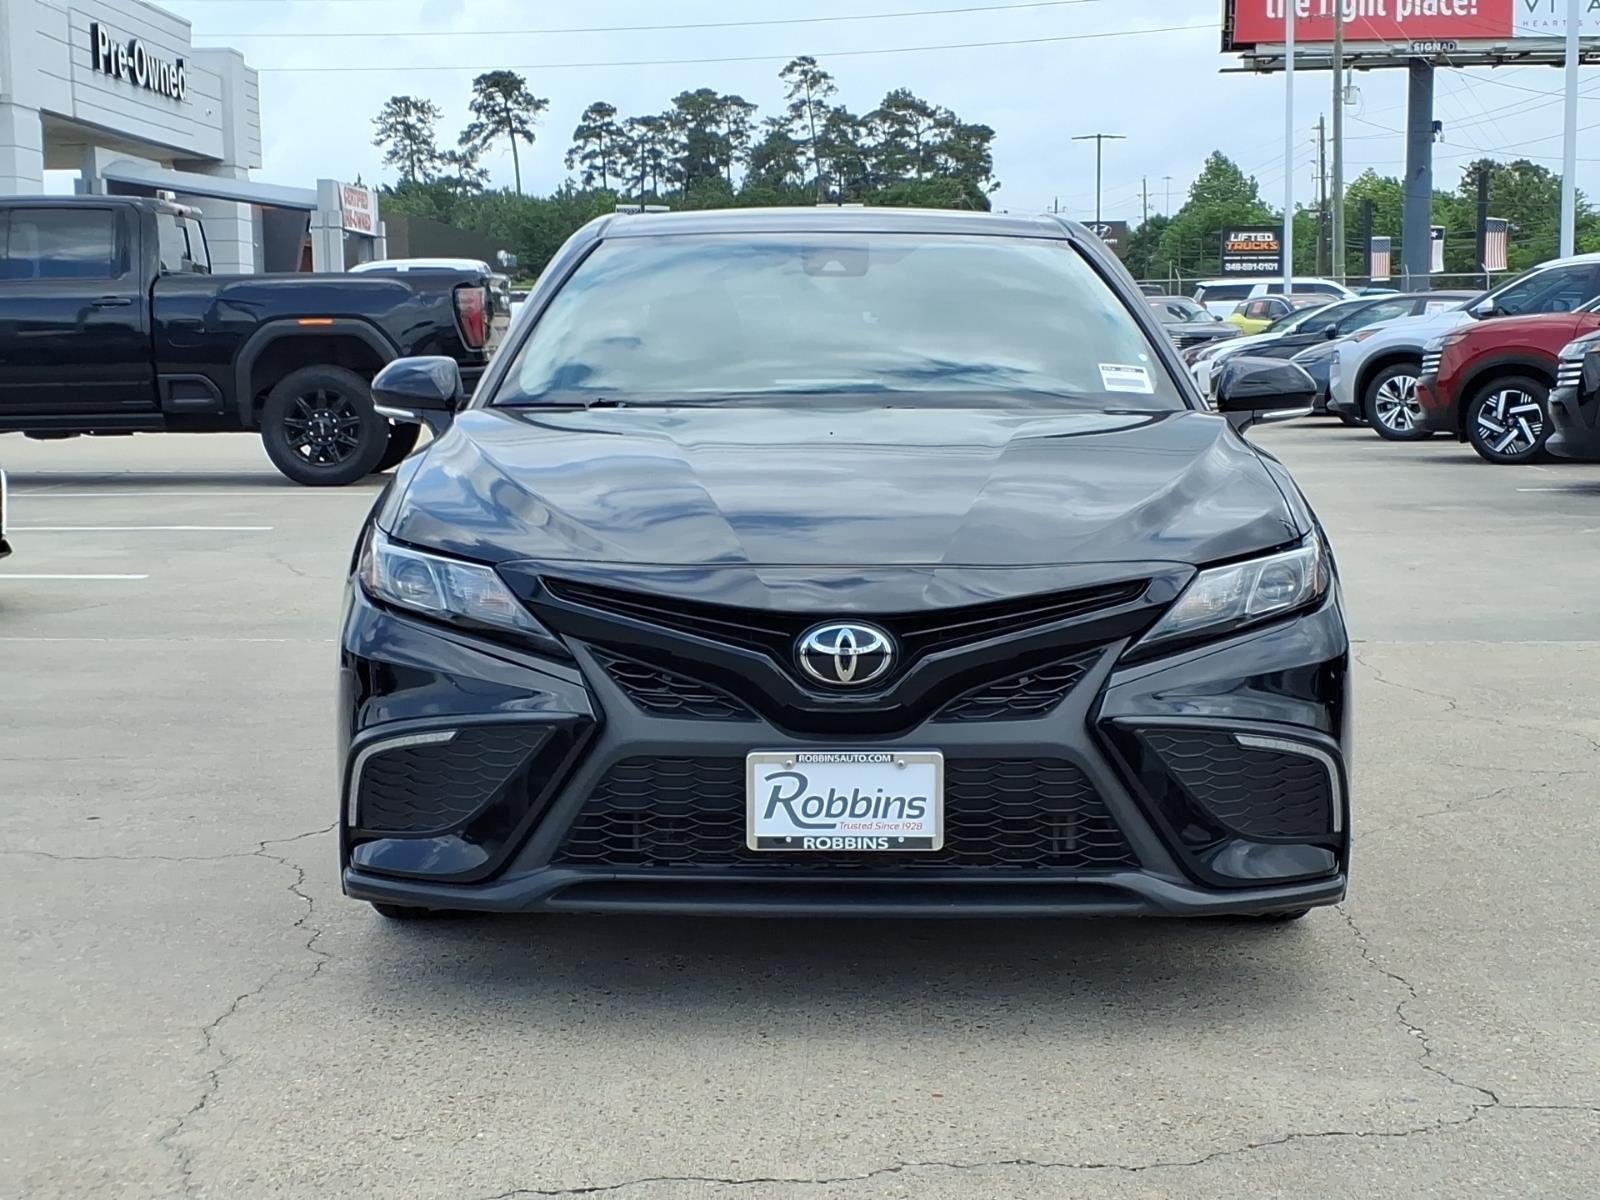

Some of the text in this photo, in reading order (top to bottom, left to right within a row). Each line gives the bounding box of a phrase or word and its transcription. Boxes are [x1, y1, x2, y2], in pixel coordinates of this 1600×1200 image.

[1265, 0, 1310, 18] te
[1396, 0, 1478, 22] place!
[90, 22, 187, 101] Pre-Owned
[1230, 233, 1273, 241] LIFTED
[1227, 240, 1278, 250] TRUCKS
[798, 754, 891, 763] ROBBINSAUTO.COM
[763, 771, 927, 829] Robbins
[840, 821, 923, 831] Trusted Since 1928
[803, 837, 889, 849] ROBBINS
